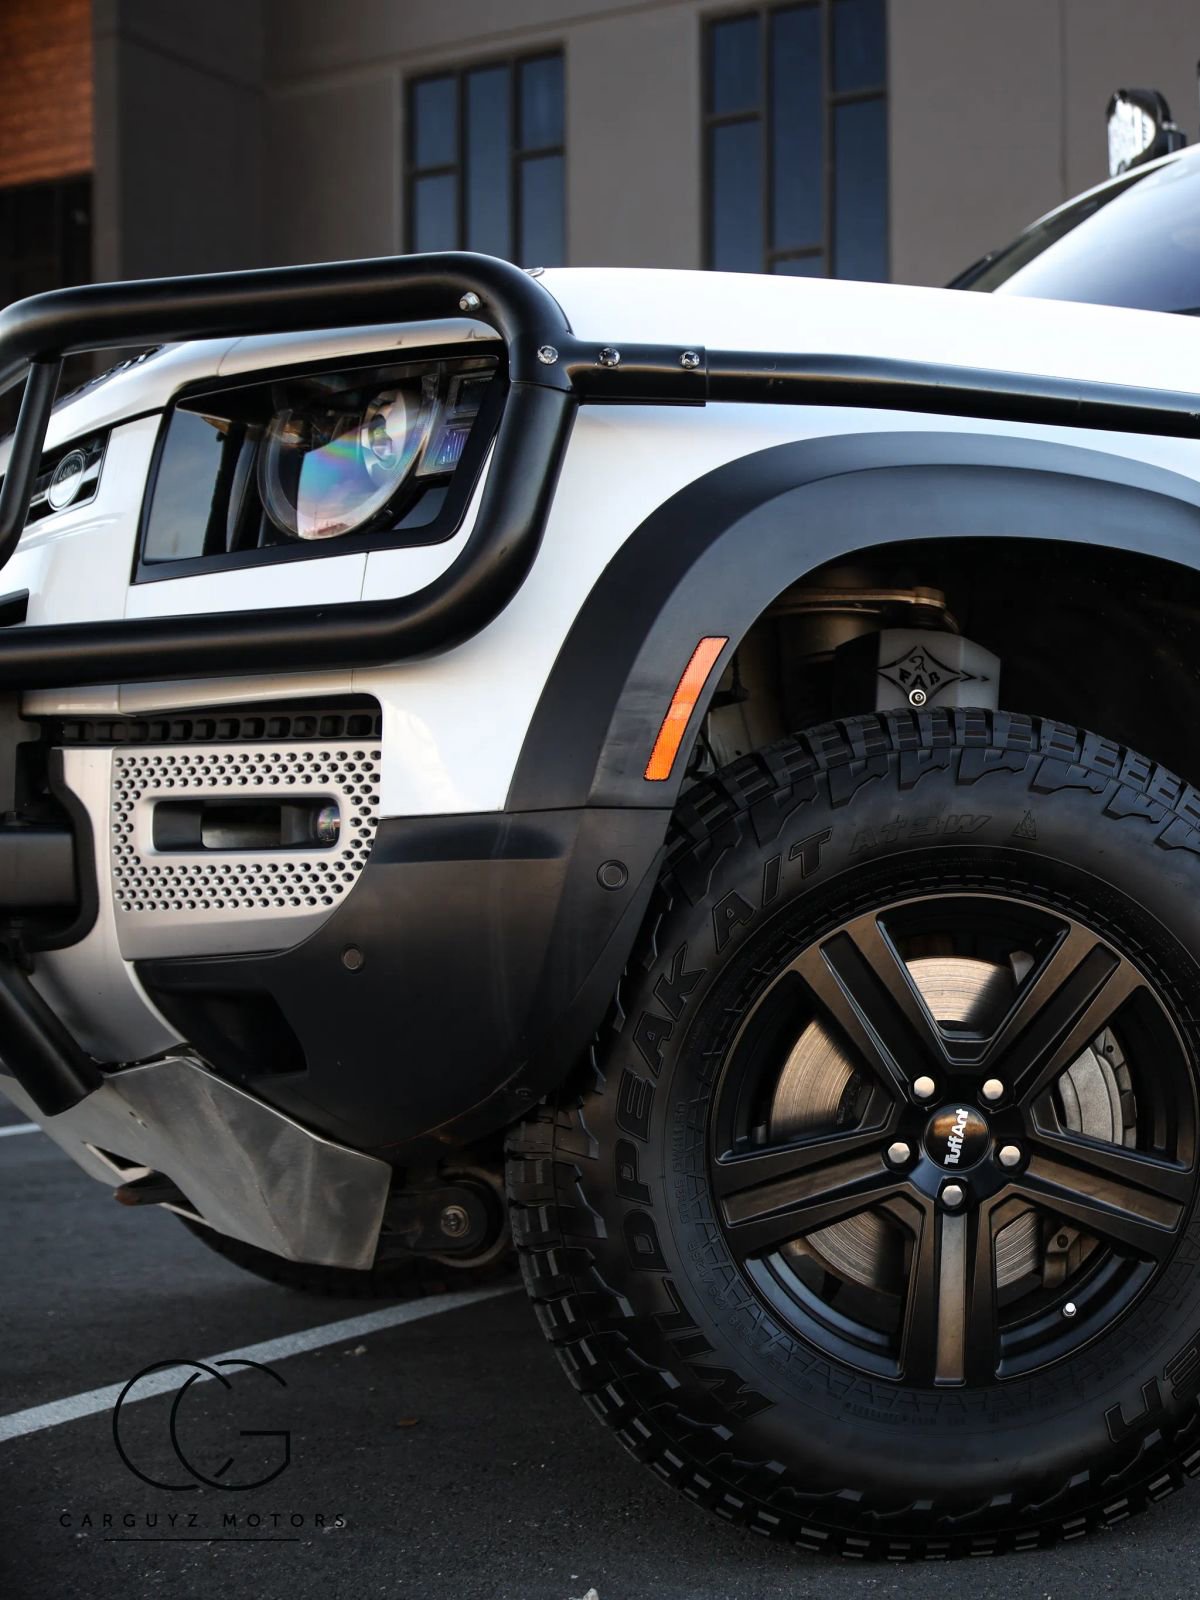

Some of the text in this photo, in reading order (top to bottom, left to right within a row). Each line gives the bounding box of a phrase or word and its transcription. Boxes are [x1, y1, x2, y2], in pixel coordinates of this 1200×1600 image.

[615, 941, 776, 1420] WILDPEAK
[711, 826, 832, 955] A/T
[944, 1108, 968, 1165] TuffAnt
